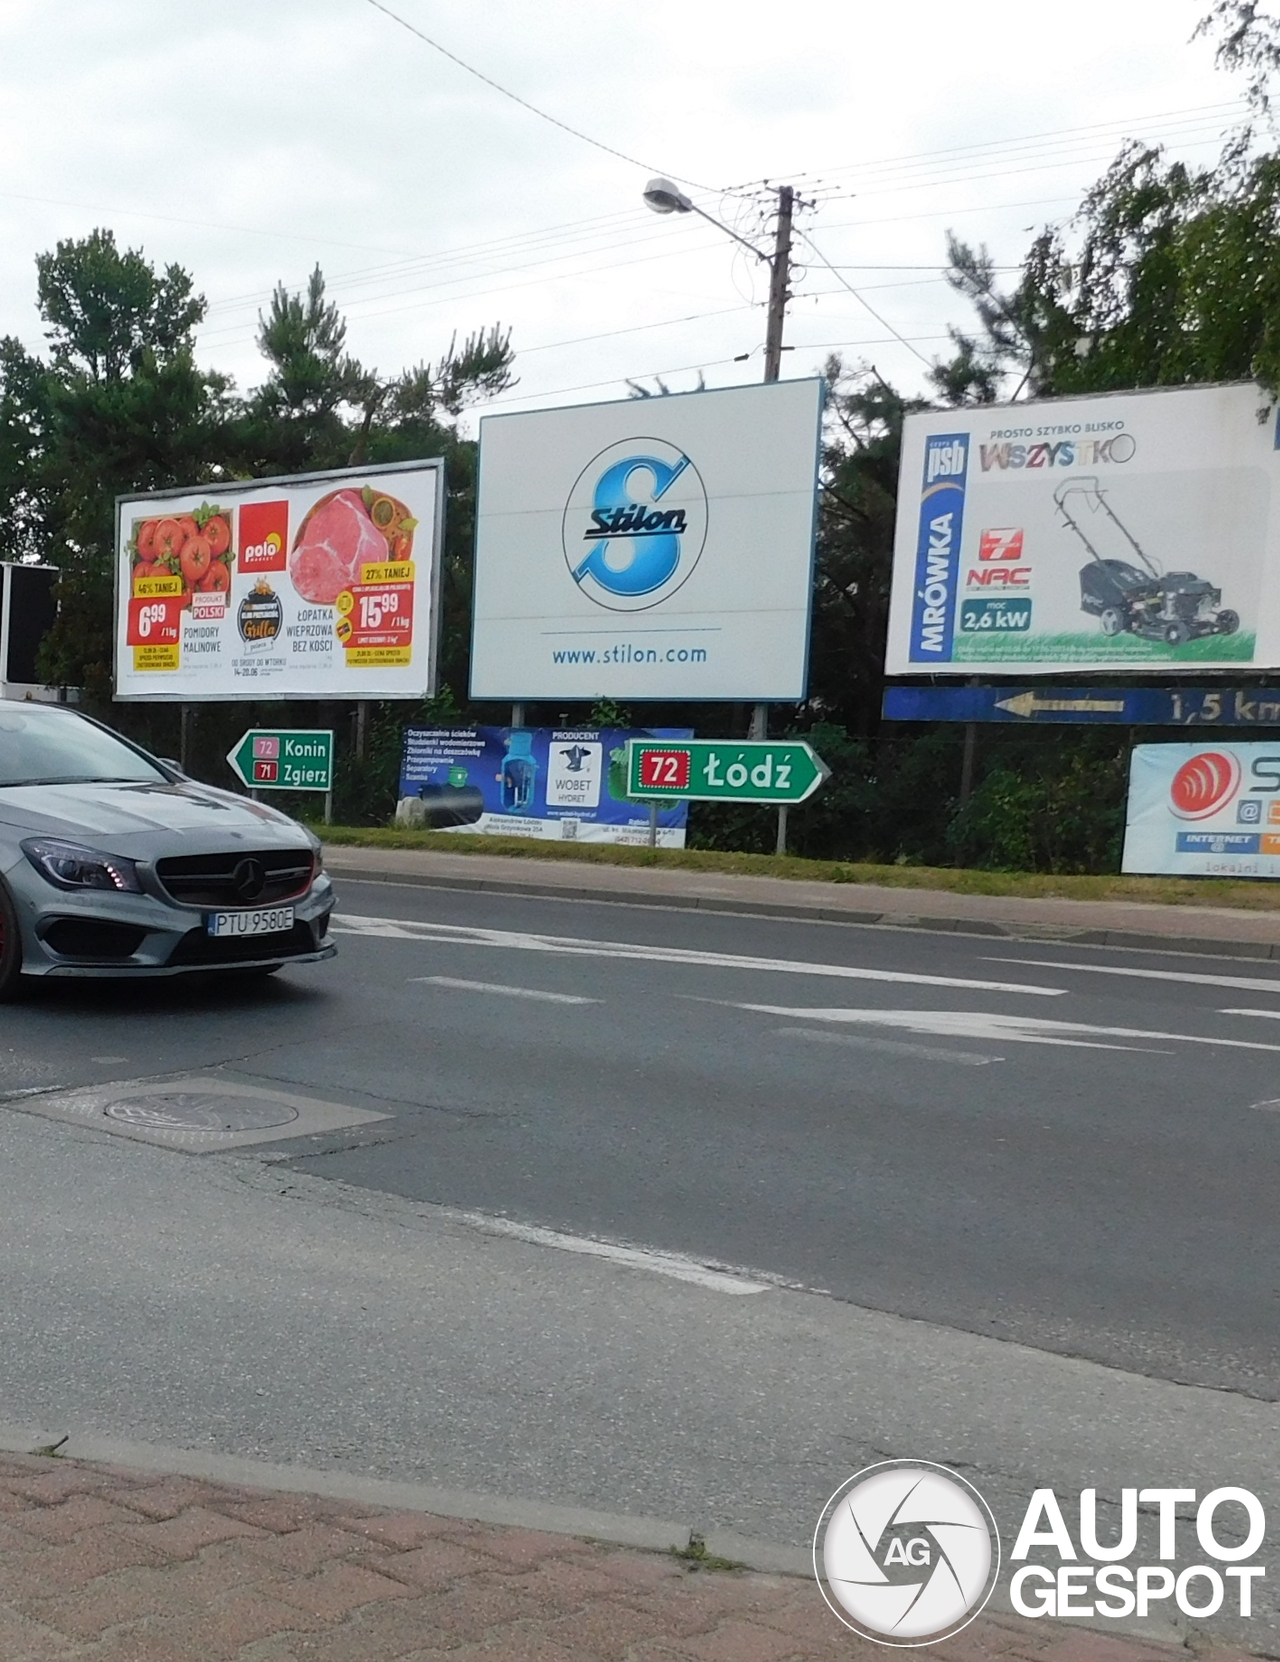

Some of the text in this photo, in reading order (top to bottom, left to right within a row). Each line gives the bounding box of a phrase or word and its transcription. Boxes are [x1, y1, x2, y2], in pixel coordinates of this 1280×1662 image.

[990, 421, 1124, 439] PROSTO SZYBKO BLISKO
[979, 433, 1136, 472] WSZYSTKO
[927, 440, 965, 482] psb
[585, 504, 688, 538] Stilon
[245, 541, 276, 562] polo
[366, 567, 410, 580] 27% TANIEJ
[966, 568, 1032, 586] NAC
[155, 582, 178, 593] TANIEJ
[918, 512, 954, 652] MRÓWKA
[194, 607, 223, 618] POLSKI
[298, 609, 333, 622] ŁOPATKA
[964, 611, 1028, 630] 2,6 kW
[184, 627, 220, 638] POMIDORY
[286, 625, 333, 637] WIEPRZOWA
[184, 641, 221, 653] MALINOWE
[292, 638, 333, 652] BEZ KOŚCI
[553, 644, 707, 665] www.stilon.com
[240, 658, 256, 666] ŚRODY
[265, 658, 286, 666] WTORKU
[552, 732, 600, 740] PRODUCENT
[260, 740, 326, 757] 72 Konin
[260, 764, 327, 785] 71 Zgierz
[650, 752, 792, 789] 72 Łódź
[555, 780, 592, 791] WOBET
[558, 794, 585, 802] HYDRET
[1186, 835, 1252, 844] INTERNET
[1205, 862, 1258, 872] lokalni
[216, 909, 292, 934] PTU 9580E
